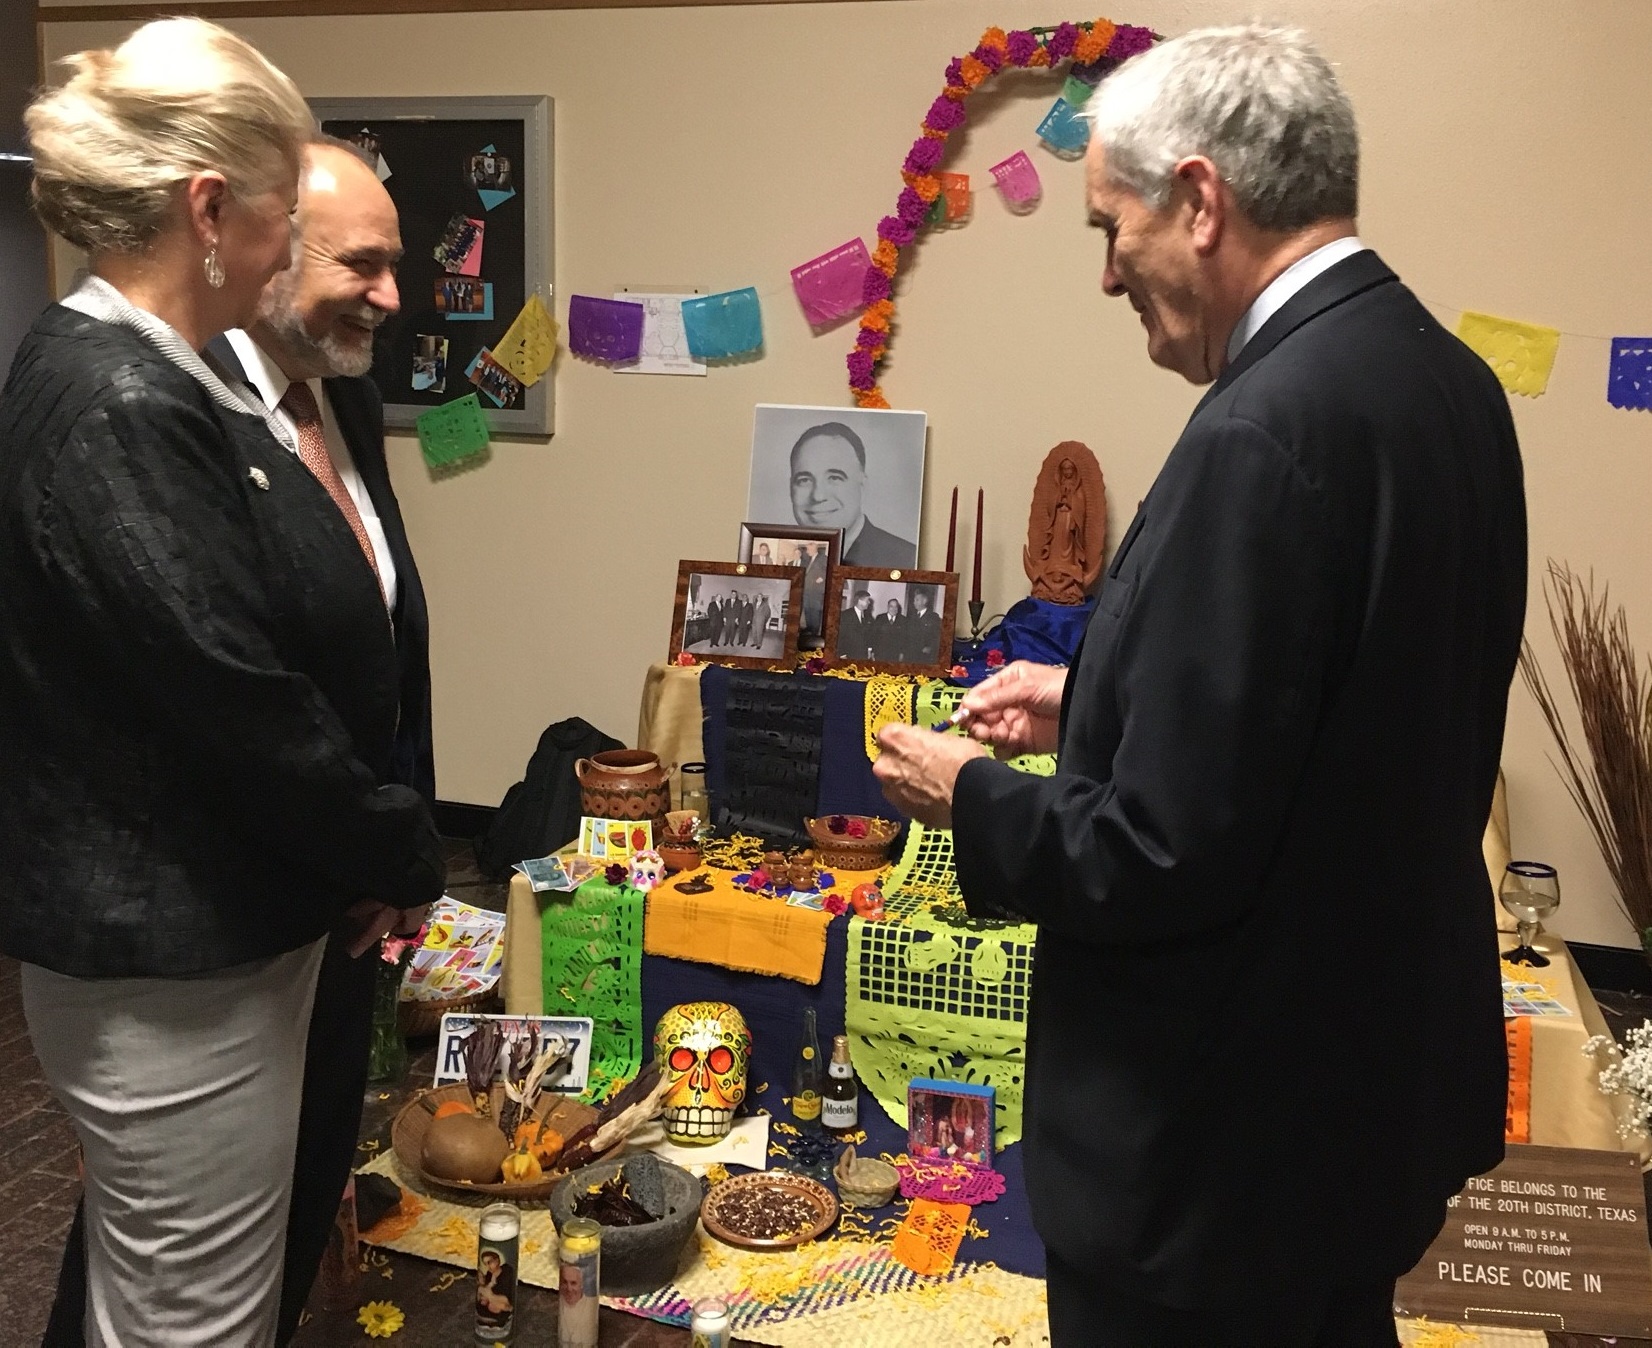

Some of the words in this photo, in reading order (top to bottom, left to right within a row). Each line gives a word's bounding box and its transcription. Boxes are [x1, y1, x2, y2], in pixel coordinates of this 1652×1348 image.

[825, 1103, 854, 1115] Modelo
[1468, 1178, 1495, 1191] FICE
[1501, 1180, 1556, 1196] BELONGS
[1561, 1185, 1577, 1198] TO
[1583, 1187, 1607, 1200] THE
[1447, 1196, 1461, 1207] OF
[1468, 1196, 1491, 1210] THE
[1498, 1199, 1529, 1213] 20TH
[1597, 1207, 1636, 1222] TEXAS
[1464, 1224, 1488, 1235] OPEN
[1493, 1227, 1499, 1236] 9
[1502, 1228, 1521, 1238] A.M.
[1525, 1229, 1537, 1239] TO
[1541, 1230, 1547, 1240] 5
[1550, 1231, 1569, 1242] P.M.
[1464, 1238, 1503, 1250] MONDAY
[1507, 1242, 1533, 1253] THRU
[1537, 1244, 1571, 1256] FRIDAY
[1439, 1262, 1511, 1285] PLEASE
[1523, 1269, 1572, 1291] COME
[1584, 1274, 1601, 1293] IN
